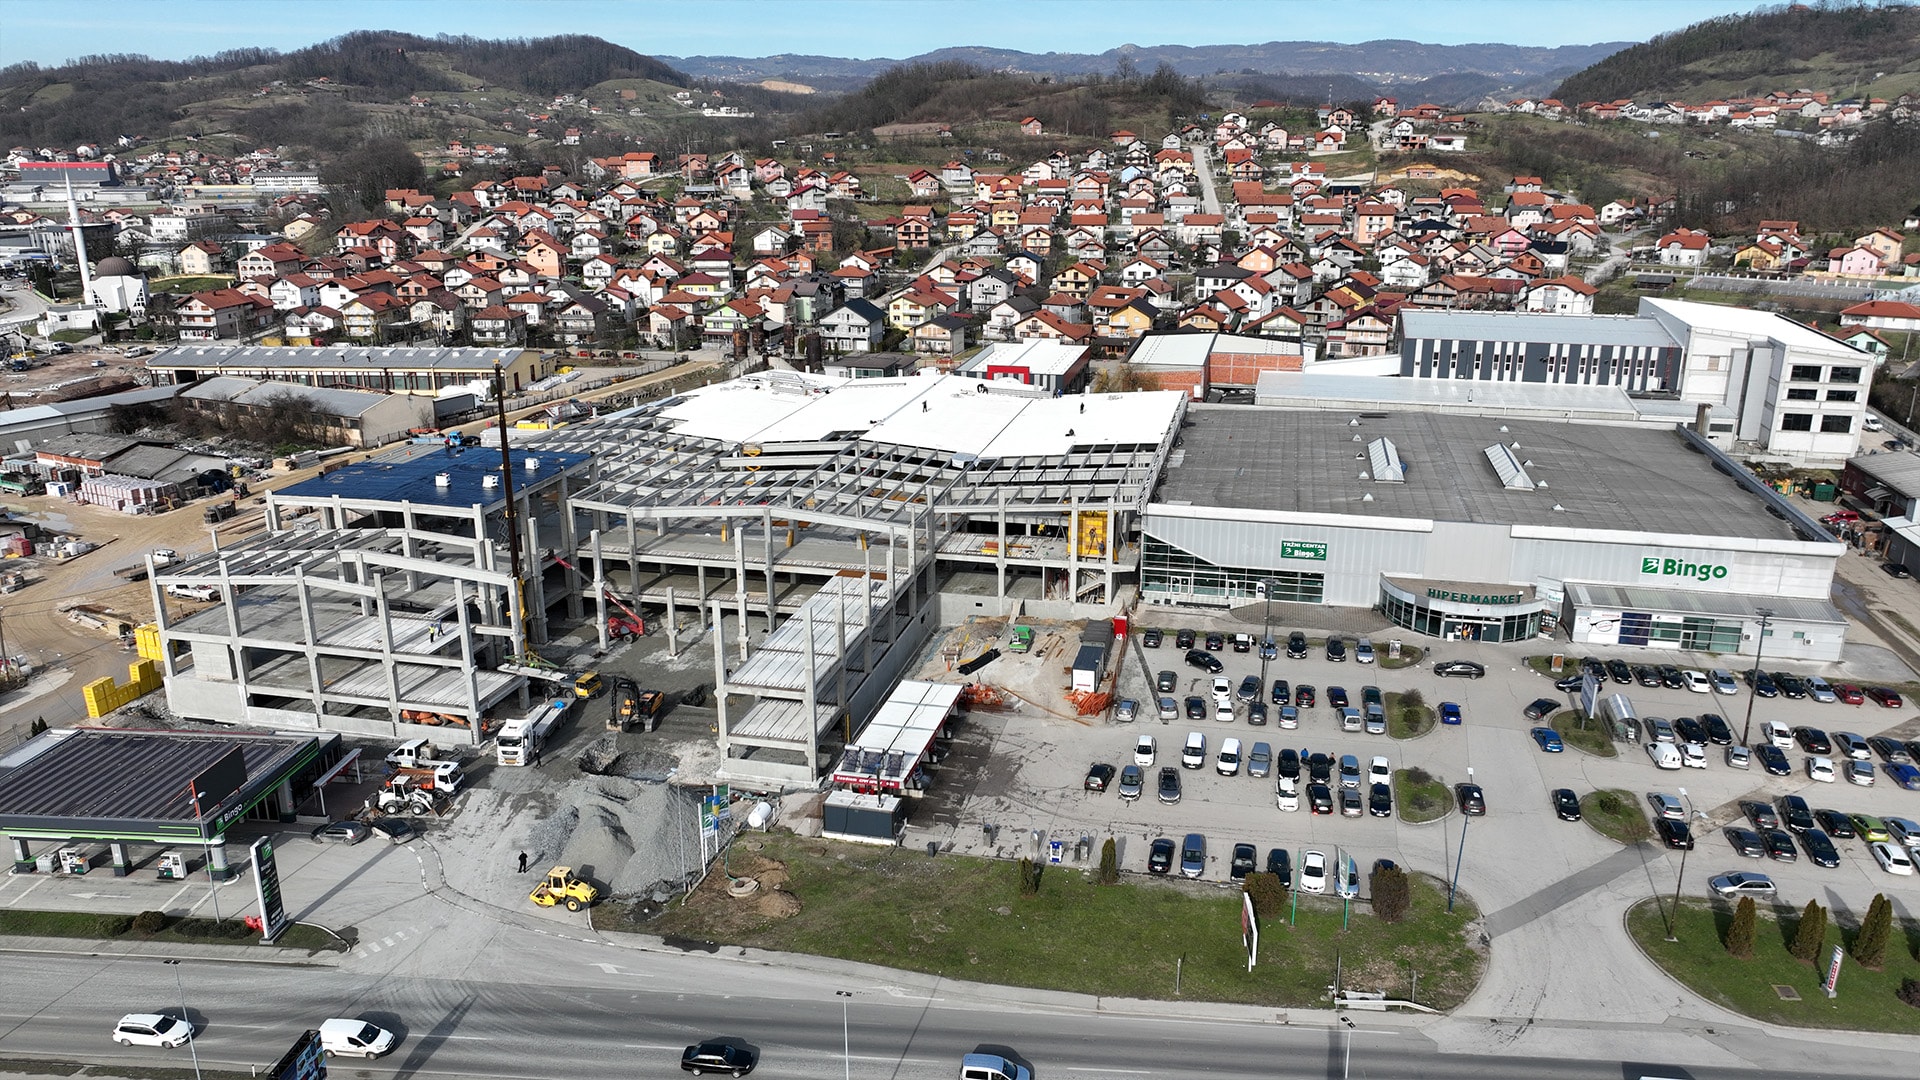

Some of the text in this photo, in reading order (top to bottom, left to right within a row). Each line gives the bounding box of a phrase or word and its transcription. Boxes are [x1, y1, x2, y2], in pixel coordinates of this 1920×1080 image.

[1293, 549, 1315, 558] Bingo
[1662, 558, 1728, 582] Bingo
[1427, 587, 1523, 605] HIPERMARKET
[223, 803, 243, 822] Bingo
